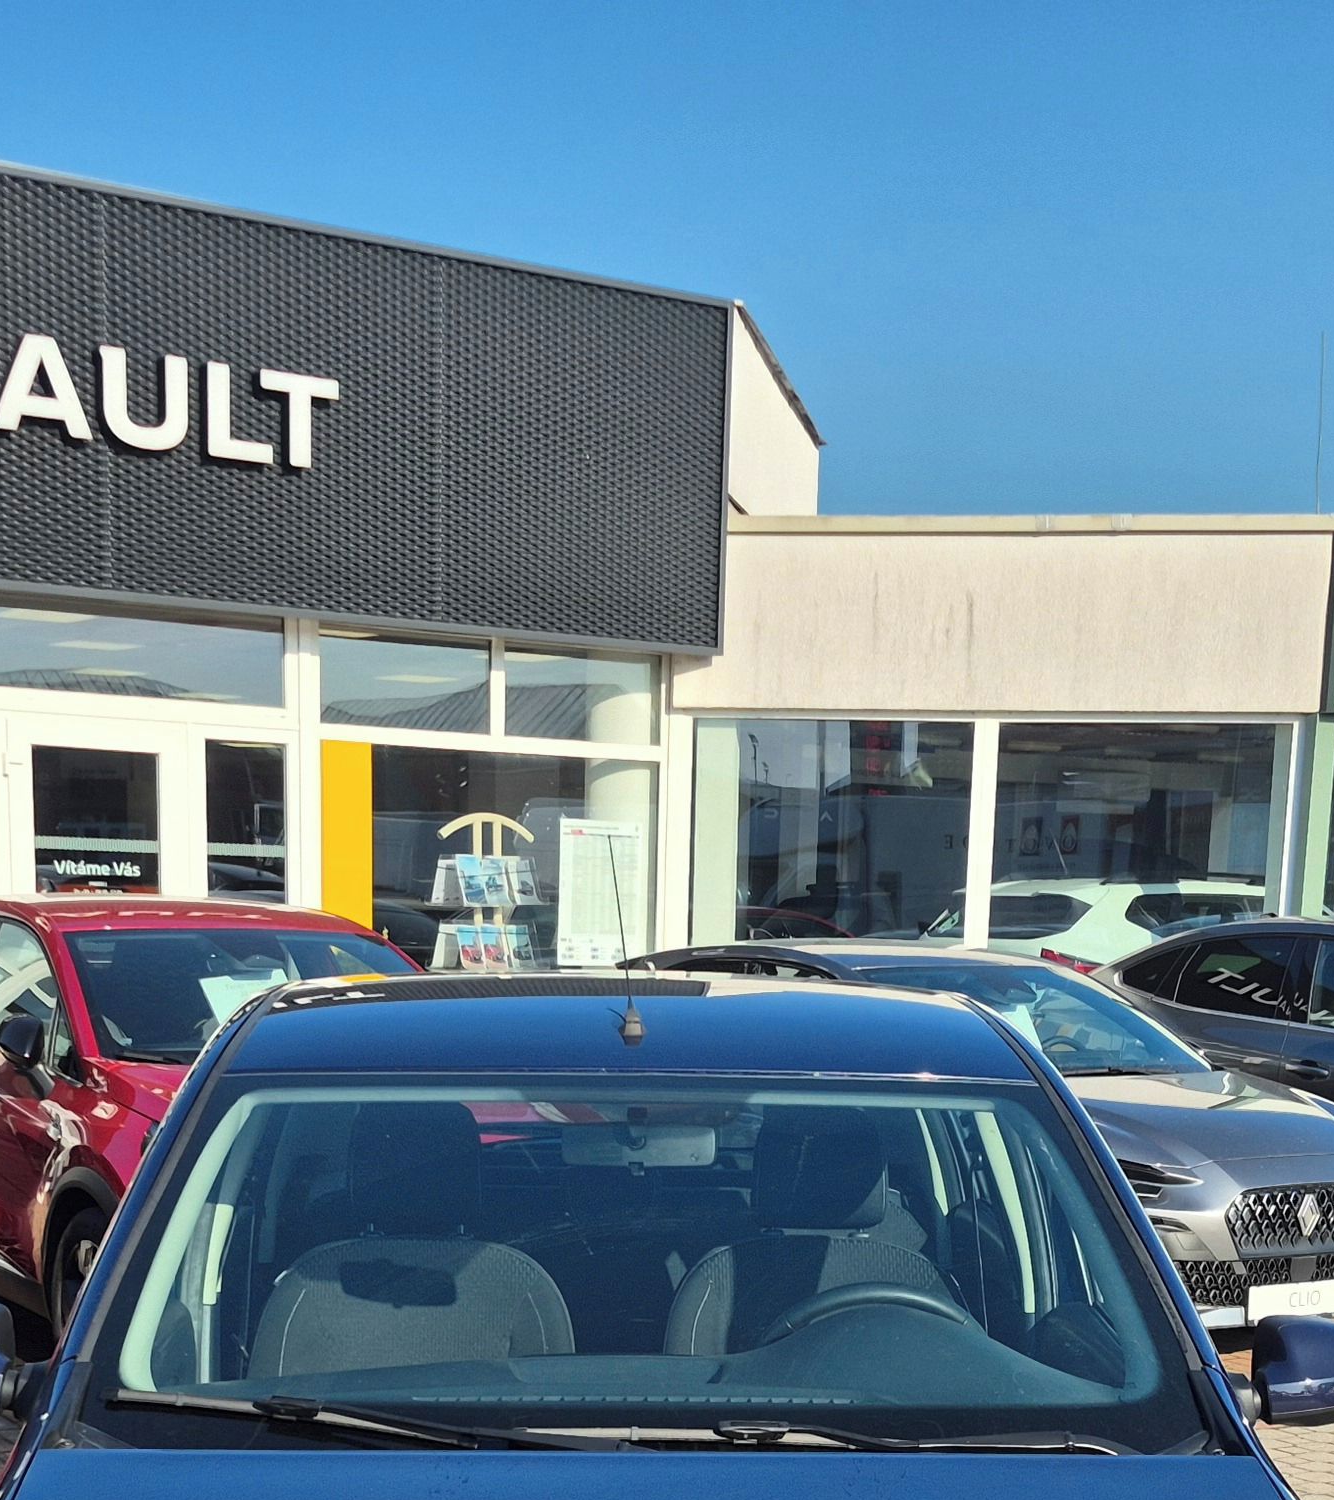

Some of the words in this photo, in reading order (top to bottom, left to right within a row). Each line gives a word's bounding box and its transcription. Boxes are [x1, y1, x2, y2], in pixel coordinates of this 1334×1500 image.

[53, 859, 110, 876] Vítáme
[112, 861, 141, 877] Vás
[1289, 1290, 1321, 1307] CLIO
